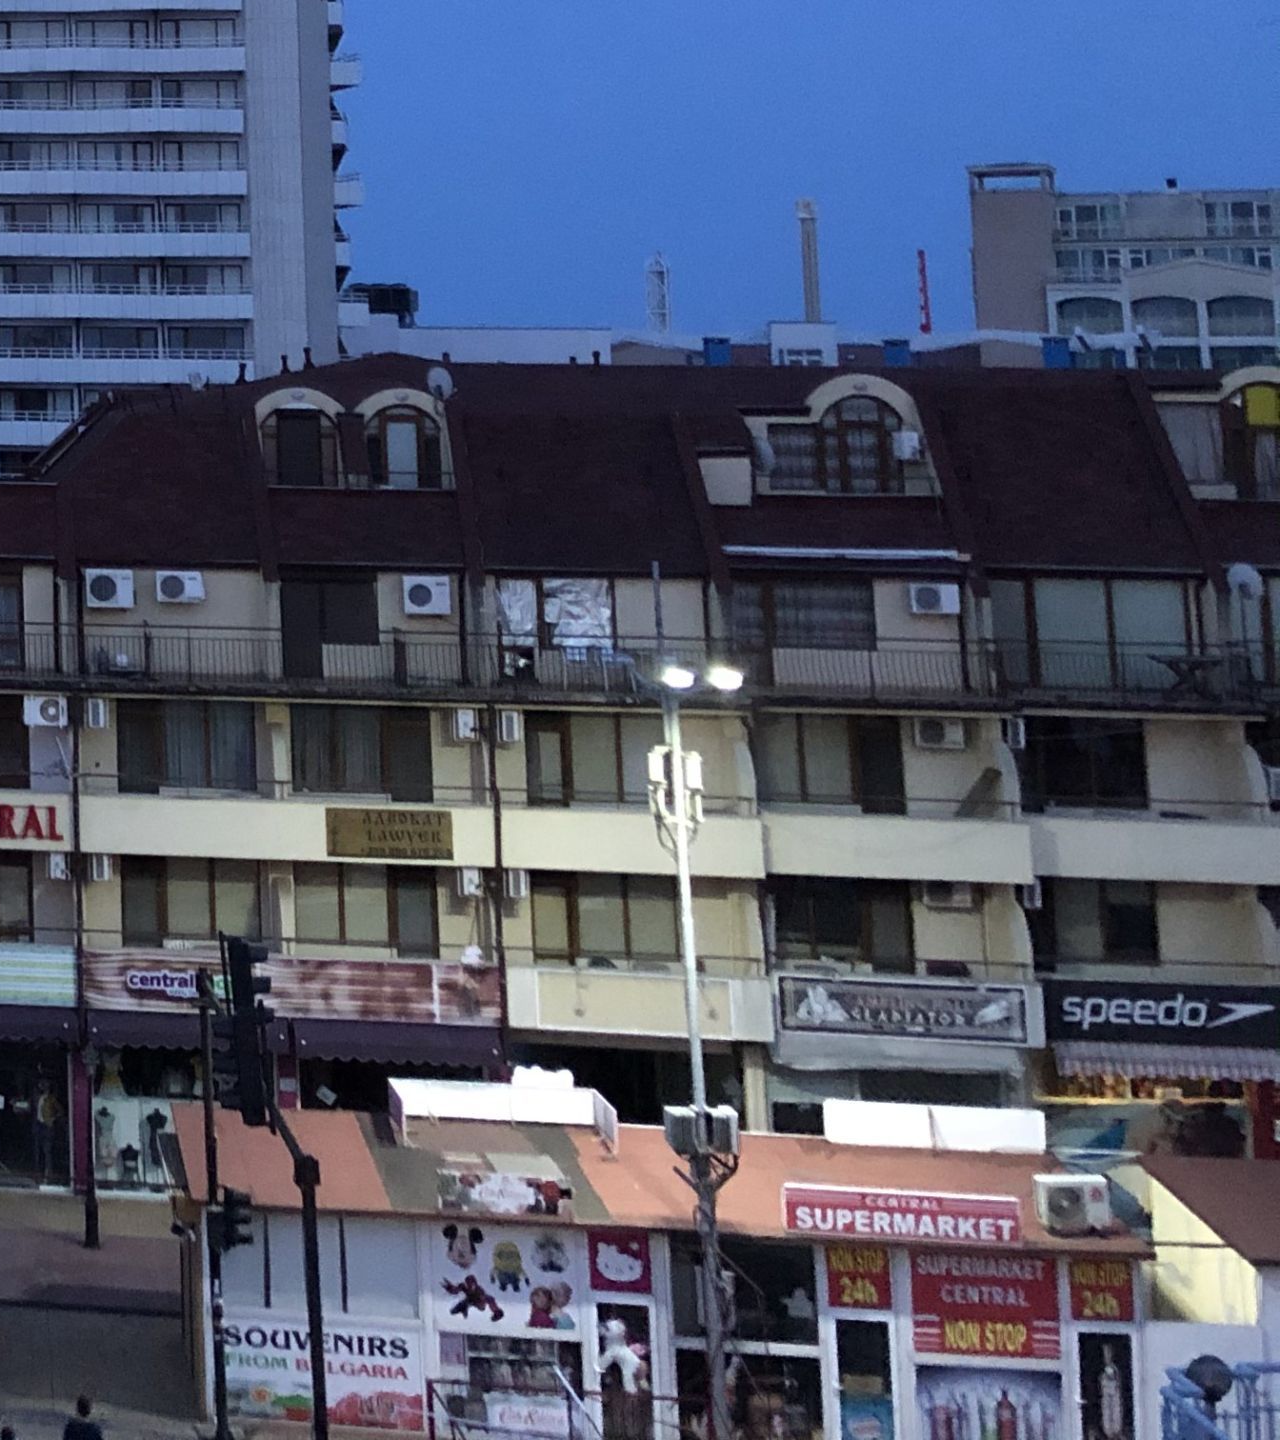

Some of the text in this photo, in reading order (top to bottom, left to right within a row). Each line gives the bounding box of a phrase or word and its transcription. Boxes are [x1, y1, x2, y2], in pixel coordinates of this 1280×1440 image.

[128, 972, 194, 989] central
[1062, 993, 1208, 1030] speedo
[795, 1205, 1016, 1241] SUPERMARKET
[856, 1250, 885, 1273] STOP
[916, 1254, 1046, 1281] SUPERMARKET
[840, 1276, 879, 1305] 24h
[940, 1283, 1030, 1308] CENTRAL
[1082, 1292, 1120, 1318] 24h
[943, 1319, 1028, 1352] NON STOP
[224, 1351, 409, 1380] FROM BLGARIA
